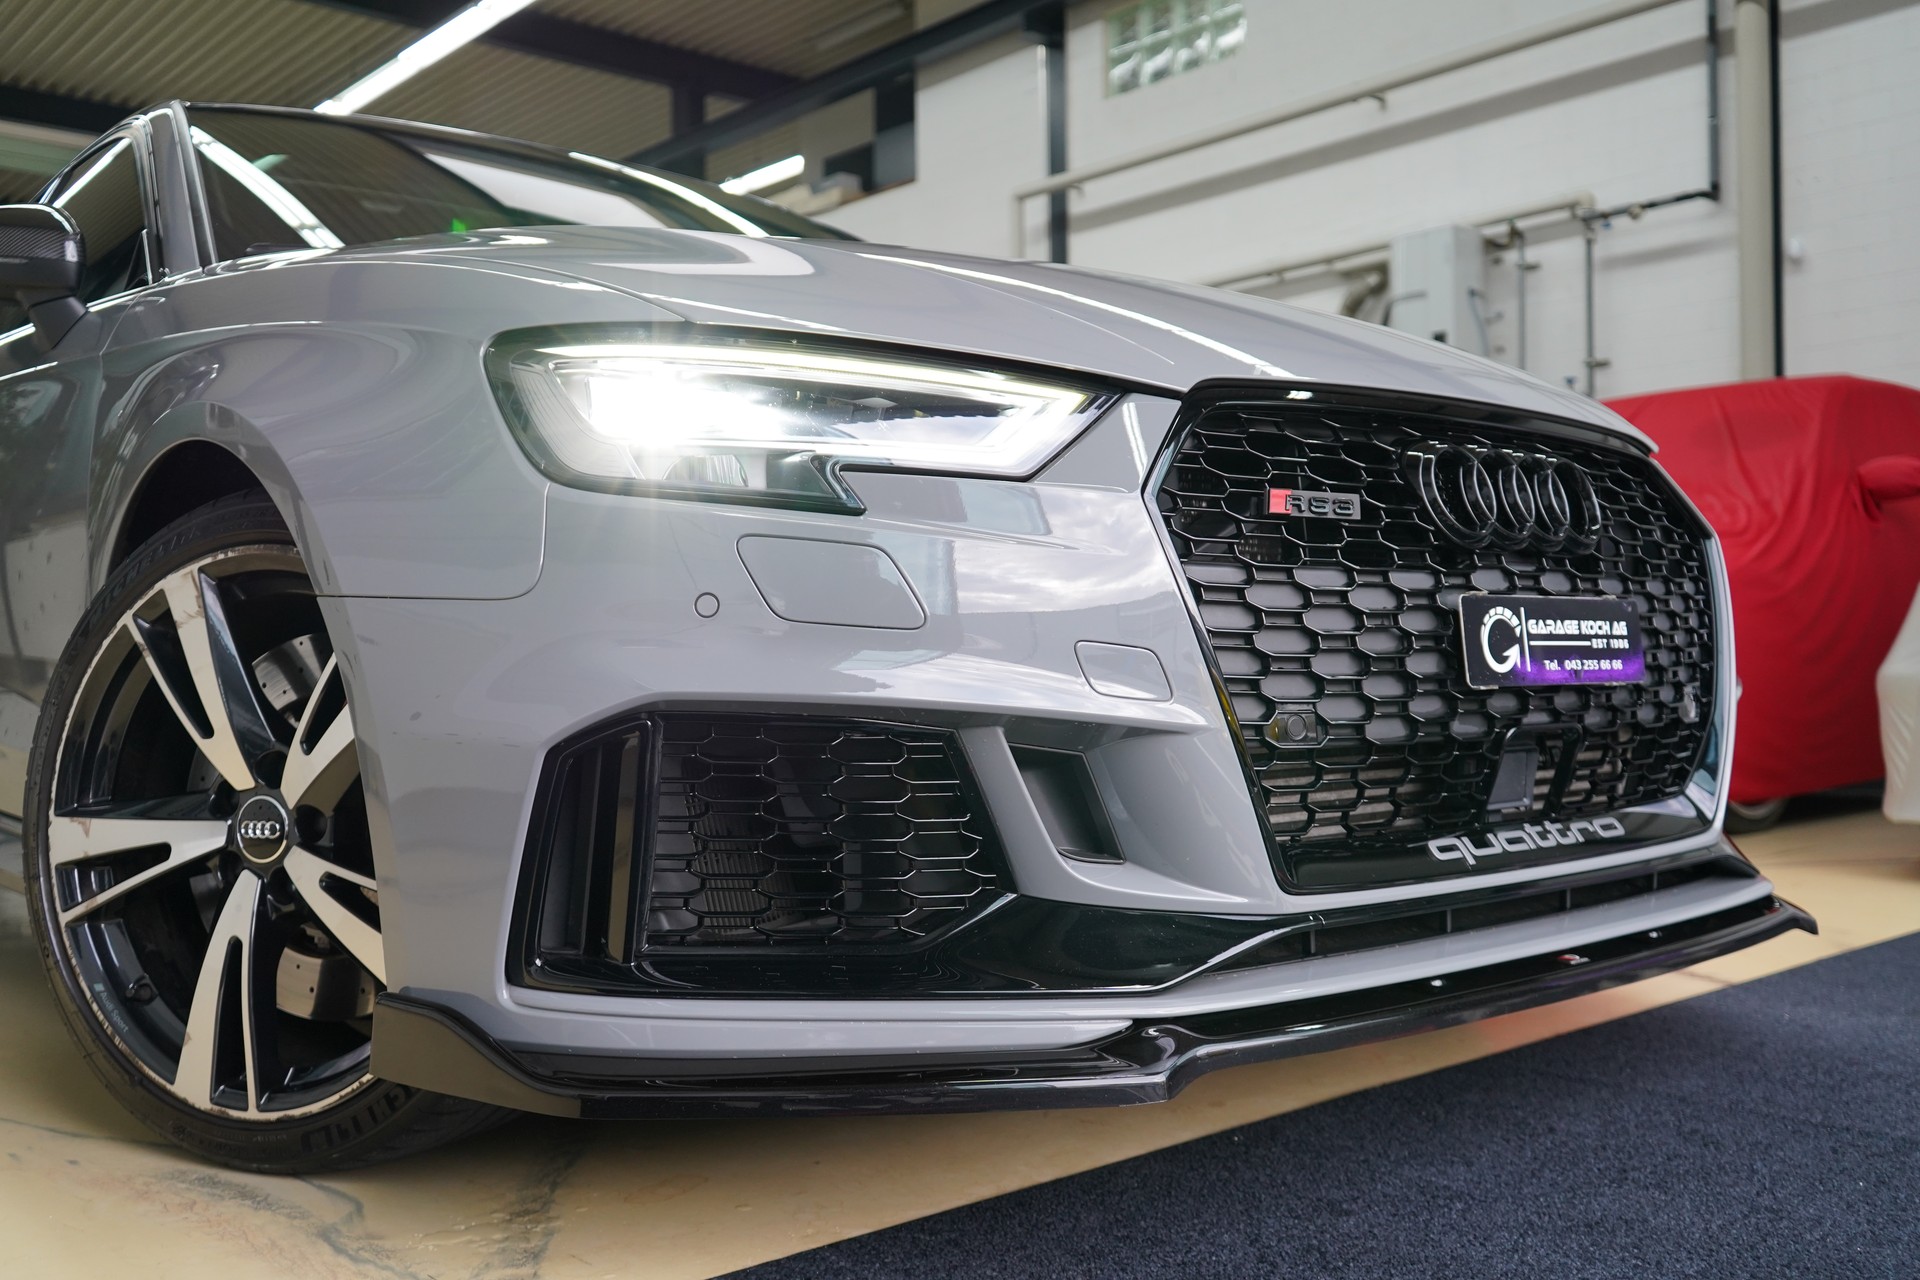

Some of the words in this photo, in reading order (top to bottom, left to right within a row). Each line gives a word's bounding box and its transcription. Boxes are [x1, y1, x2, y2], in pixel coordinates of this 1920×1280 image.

[1285, 494, 1354, 515] RS3
[1527, 619, 1580, 635] GARAGE
[1580, 620, 1611, 635] KOCH
[1611, 620, 1628, 636] AG
[1591, 638, 1608, 649] EST
[1543, 659, 1562, 671] Tel.
[1564, 659, 1582, 671] 043
[1582, 659, 1600, 671] 255
[1600, 659, 1611, 670] 66
[1611, 659, 1623, 670] 66
[1428, 817, 1625, 866] quattro
